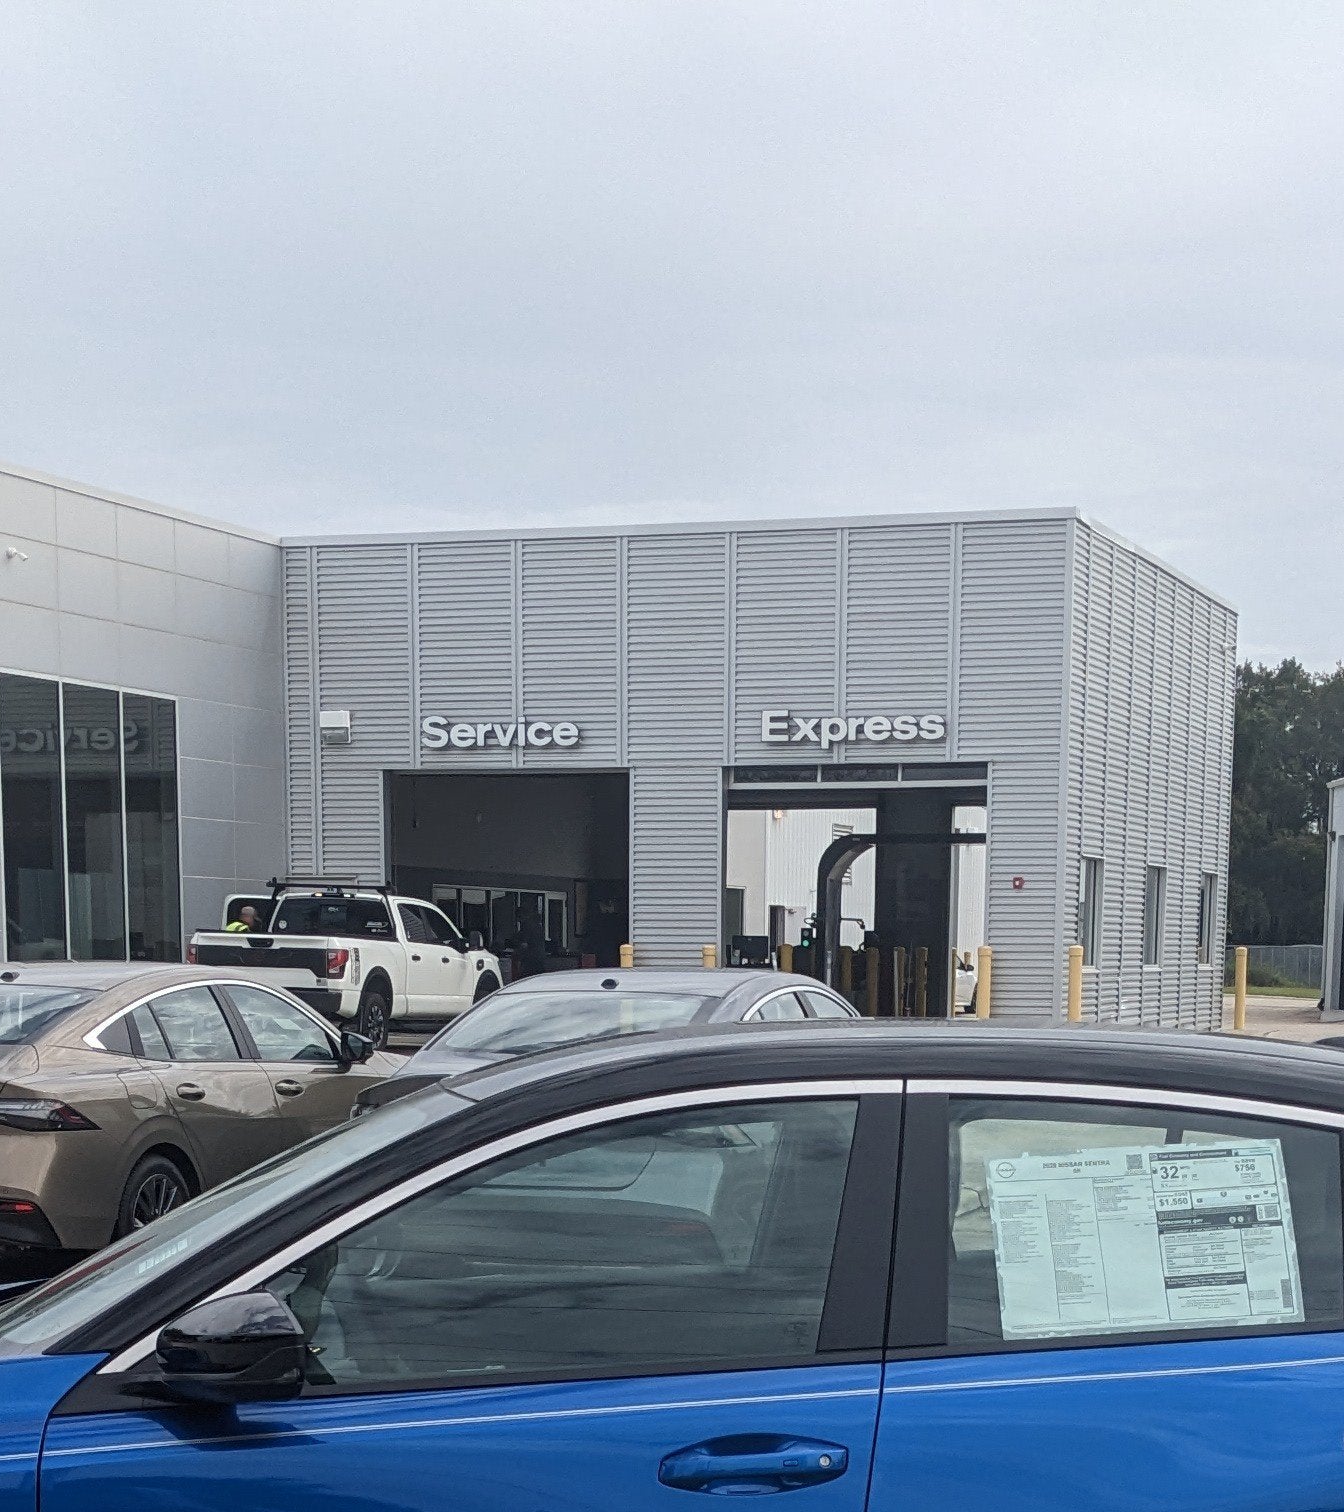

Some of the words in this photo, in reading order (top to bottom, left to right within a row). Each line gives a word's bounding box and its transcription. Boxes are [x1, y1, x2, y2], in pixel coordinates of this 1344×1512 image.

[422, 715, 579, 748] Service
[761, 710, 945, 749] Express
[1160, 1165, 1179, 1180] 32
